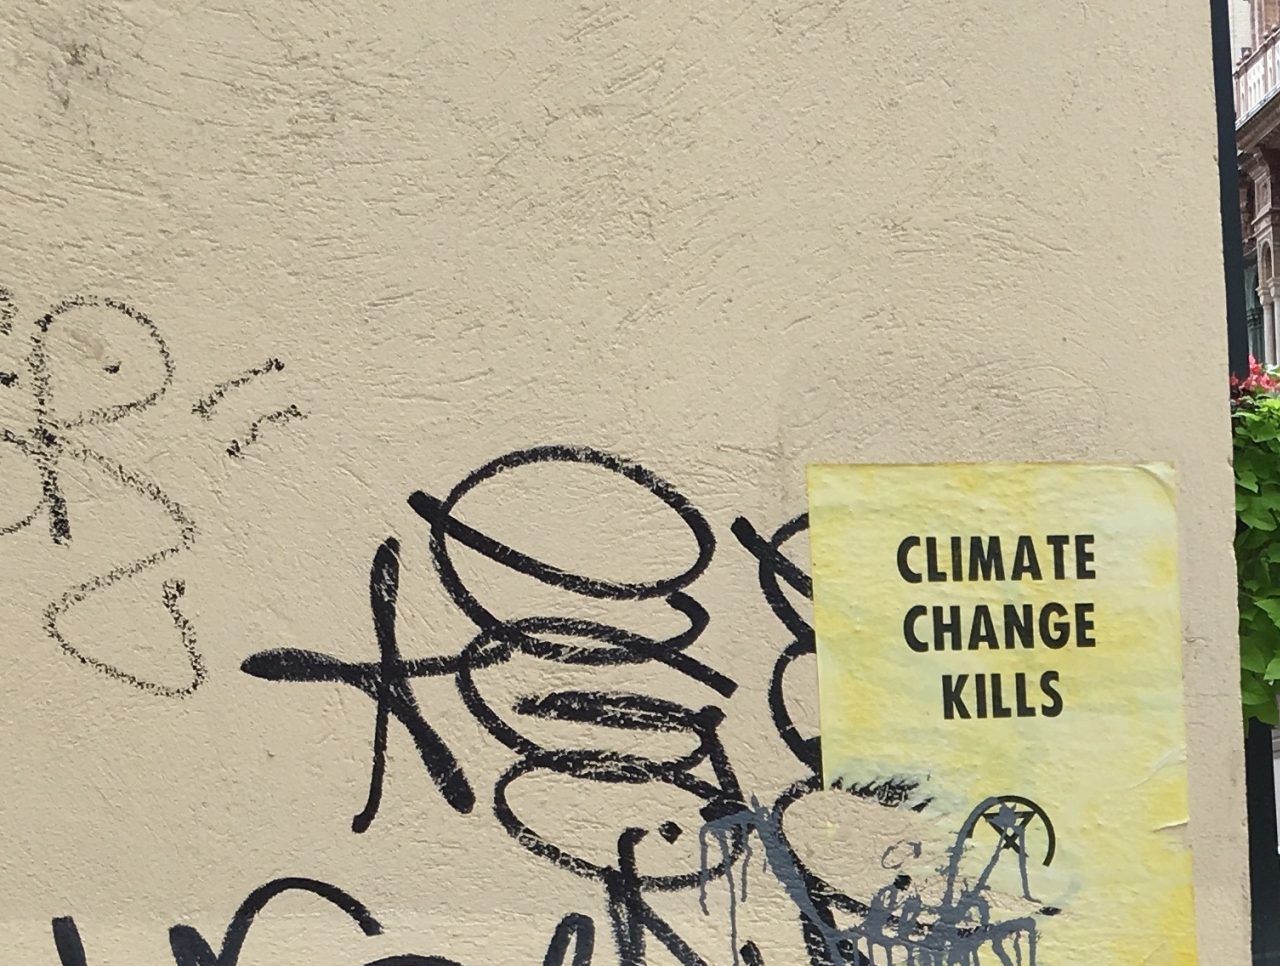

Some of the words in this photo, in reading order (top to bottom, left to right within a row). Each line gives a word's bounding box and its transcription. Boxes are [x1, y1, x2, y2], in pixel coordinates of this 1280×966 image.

[896, 534, 1097, 583] CLIMATE
[902, 602, 1097, 653] CHANGE
[941, 670, 1065, 720] KILLS
